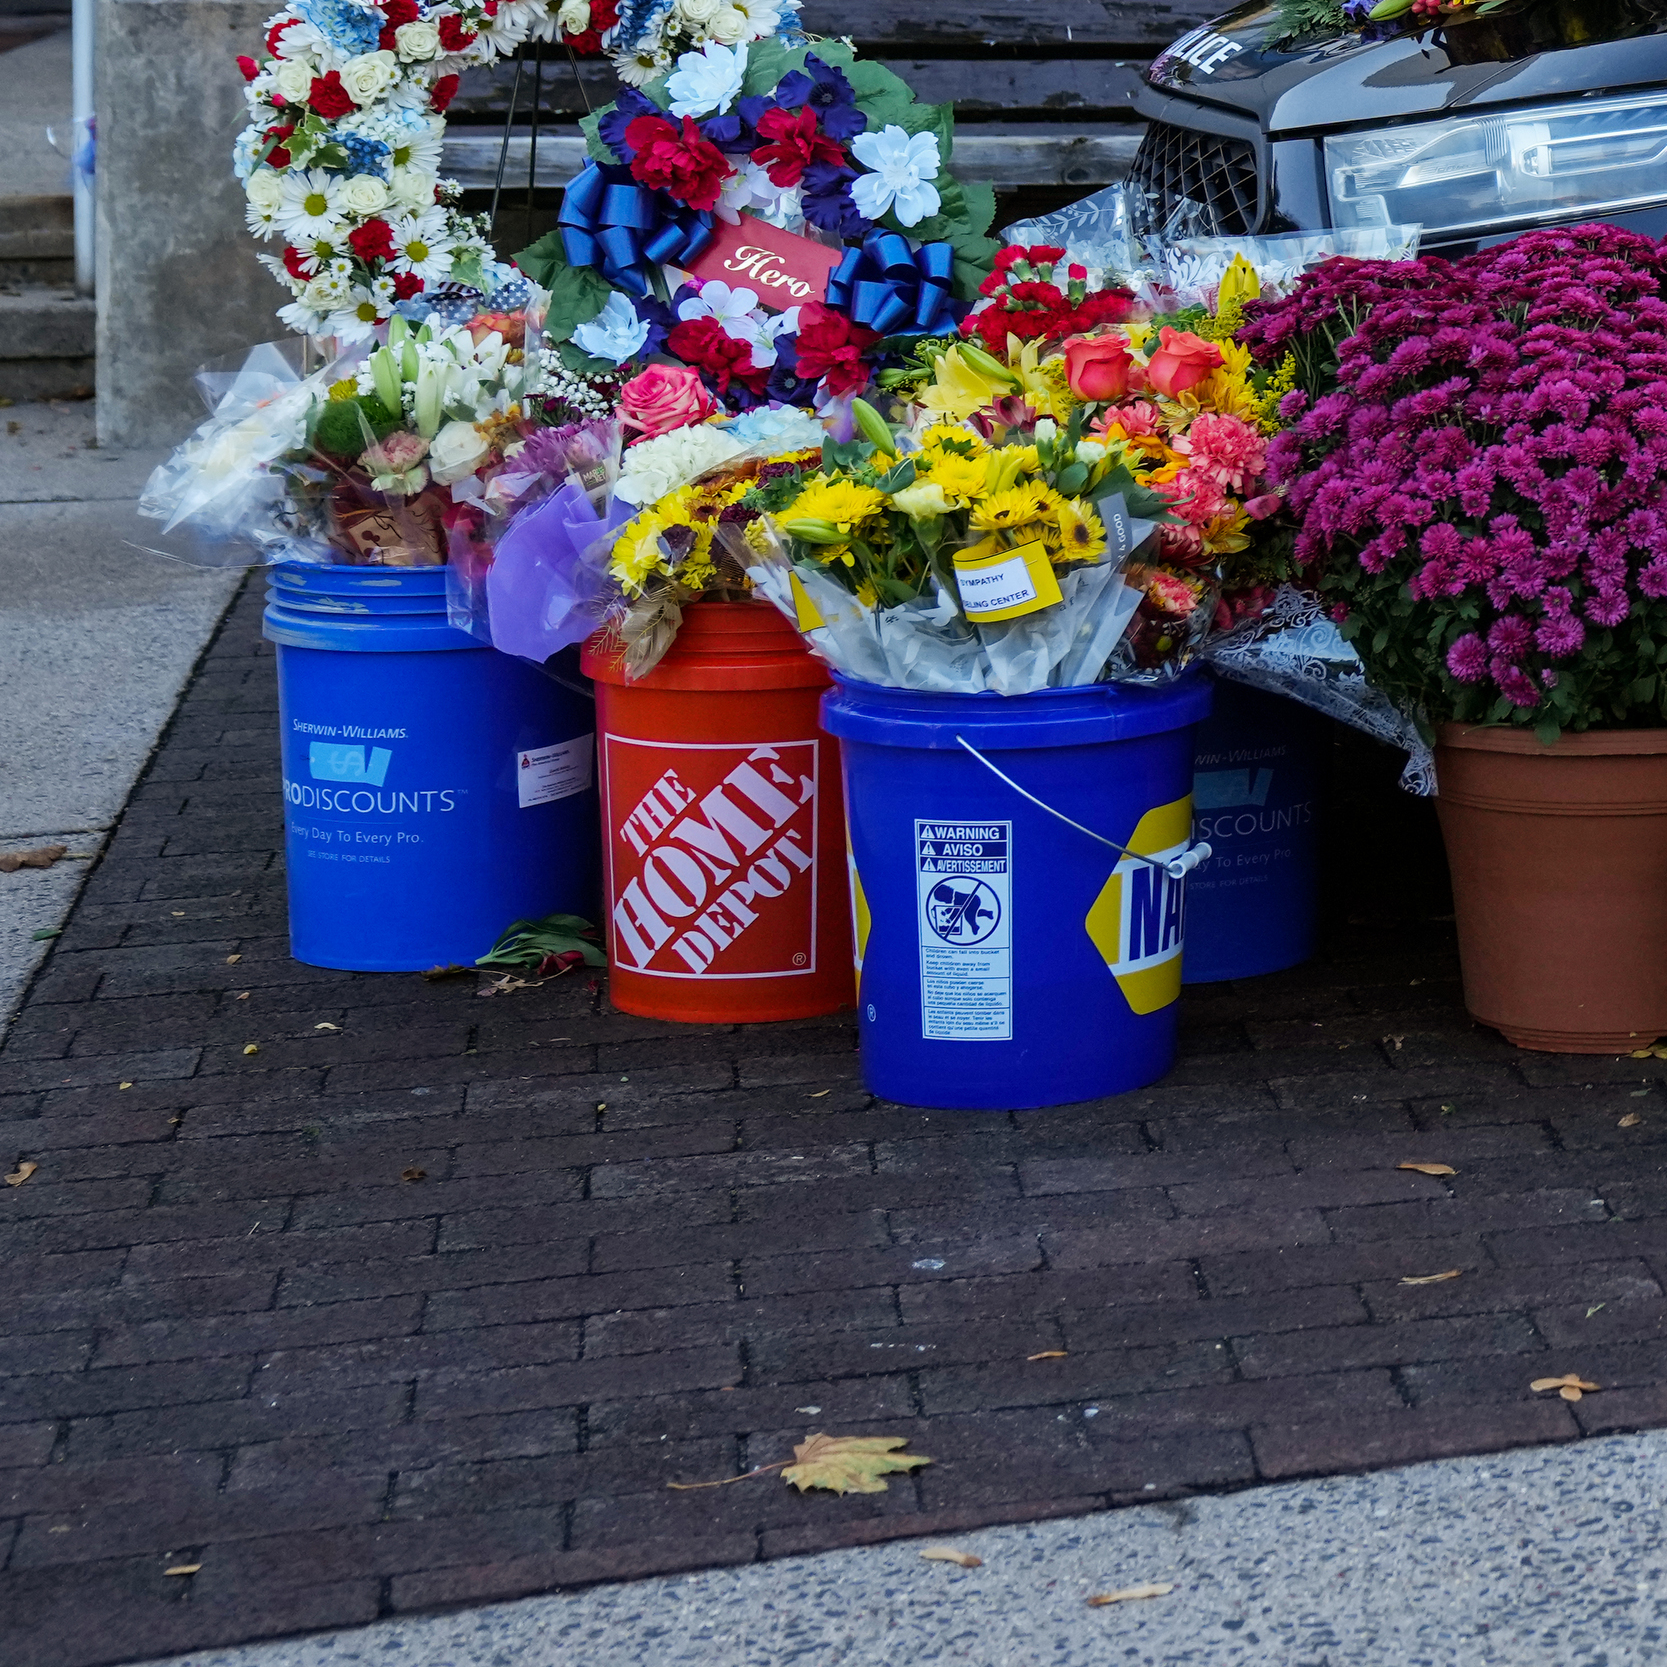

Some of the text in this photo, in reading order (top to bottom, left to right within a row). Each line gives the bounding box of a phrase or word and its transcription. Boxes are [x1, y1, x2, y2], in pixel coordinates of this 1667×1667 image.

[723, 244, 816, 299] Hero
[1113, 513, 1127, 543] GOOD
[990, 589, 1030, 607] CENTER
[619, 769, 697, 858] THE
[291, 821, 309, 839] Every
[312, 827, 332, 843] Day
[337, 830, 351, 842] To
[355, 832, 392, 846] Every
[935, 827, 1000, 839] WARNING
[318, 852, 338, 861] STORE
[342, 854, 356, 862] FOR
[359, 855, 390, 864] DETAILS
[612, 746, 818, 971] HOME
[943, 843, 983, 856] AVISO
[1217, 856, 1231, 867] To
[1237, 851, 1270, 866] Every
[937, 860, 1005, 872] AVERTISSEMENT
[670, 827, 815, 976] DEPOT
